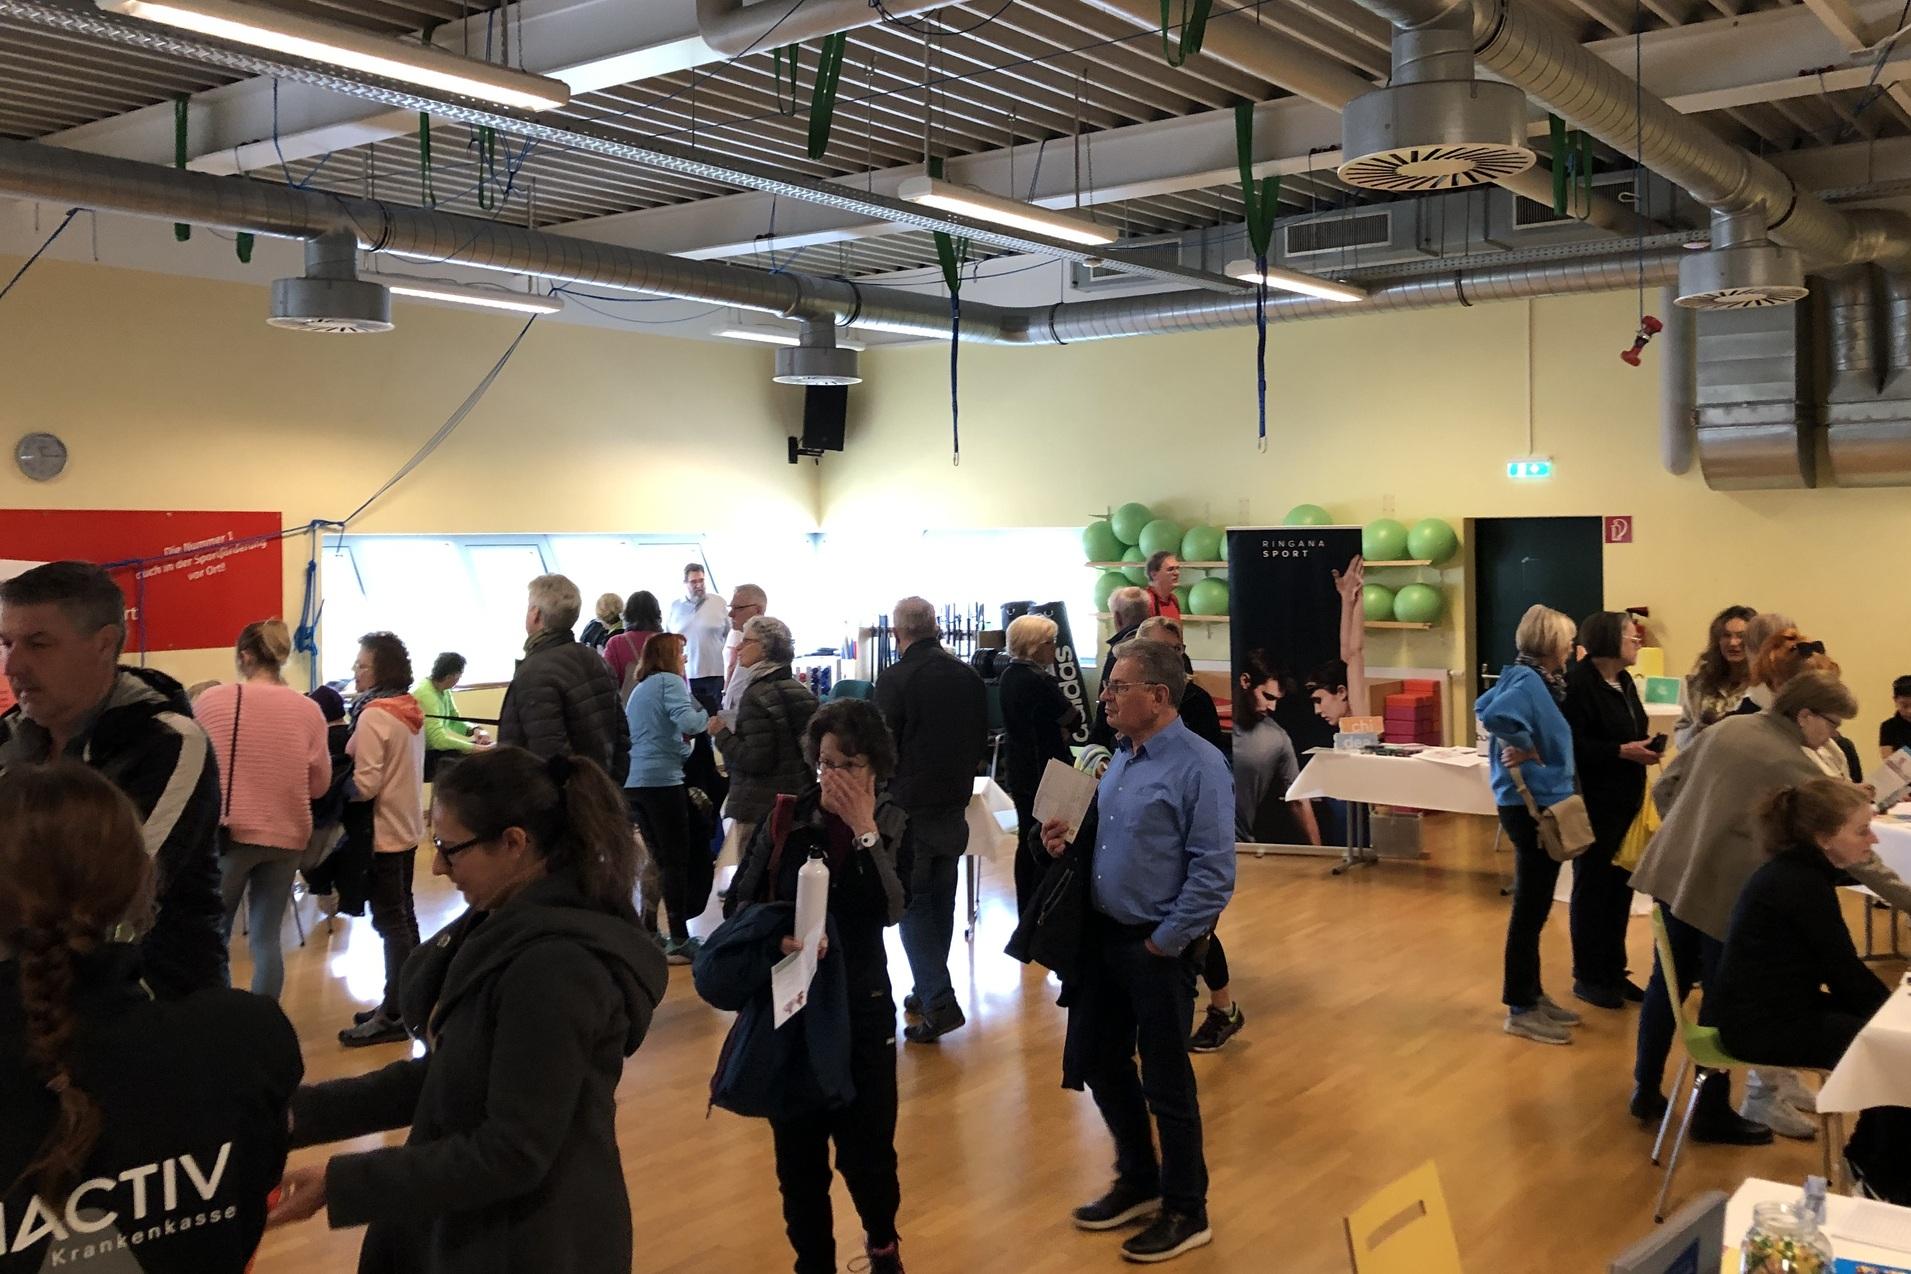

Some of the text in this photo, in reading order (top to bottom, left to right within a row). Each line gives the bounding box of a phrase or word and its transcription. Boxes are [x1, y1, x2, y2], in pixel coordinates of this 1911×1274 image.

[1262, 540, 1325, 548] RINGANA
[1262, 550, 1308, 558] SPORT
[51, 1204, 237, 1267] Krankenkasse
